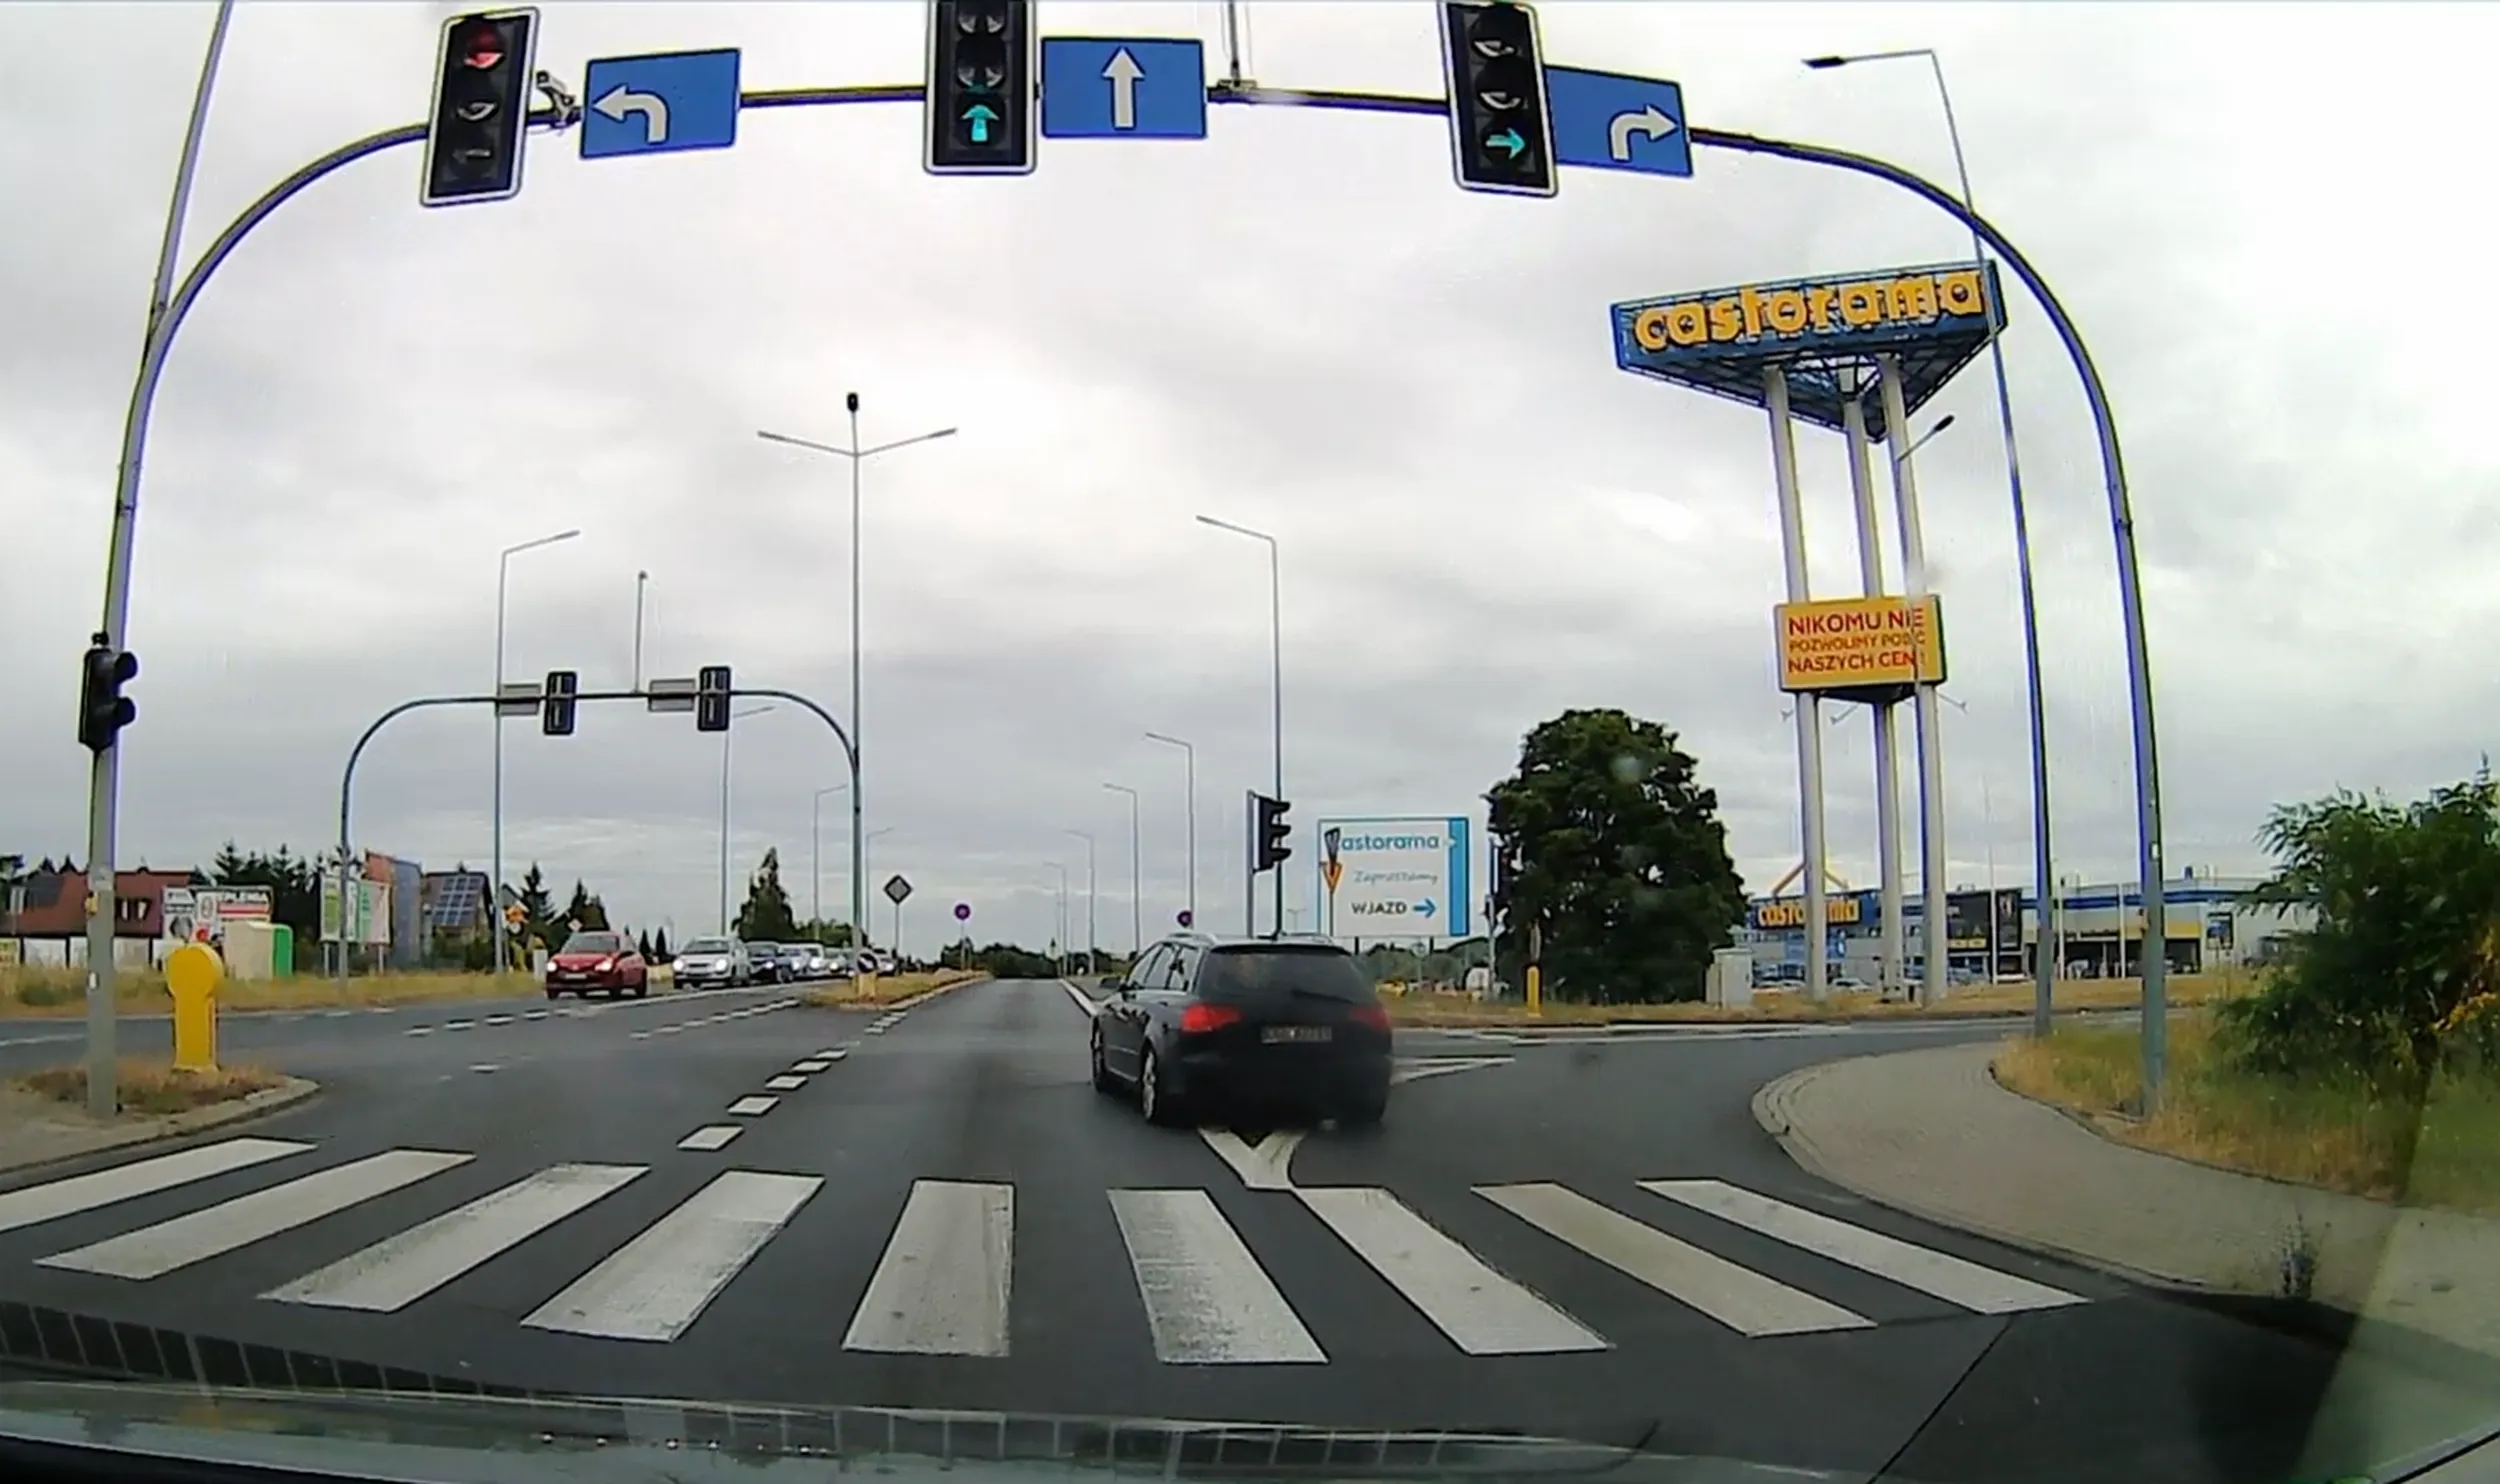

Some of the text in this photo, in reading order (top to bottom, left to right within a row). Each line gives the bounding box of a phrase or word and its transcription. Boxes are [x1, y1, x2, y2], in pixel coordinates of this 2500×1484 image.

[1634, 270, 1988, 351] castorama
[1788, 607, 1925, 636] NIKOMU NIE
[1788, 634, 1878, 653] POZWOLIMY
[1787, 654, 1874, 673] NASZYCH
[1340, 833, 1440, 851] astorama
[1351, 901, 1408, 915] WJAZD
